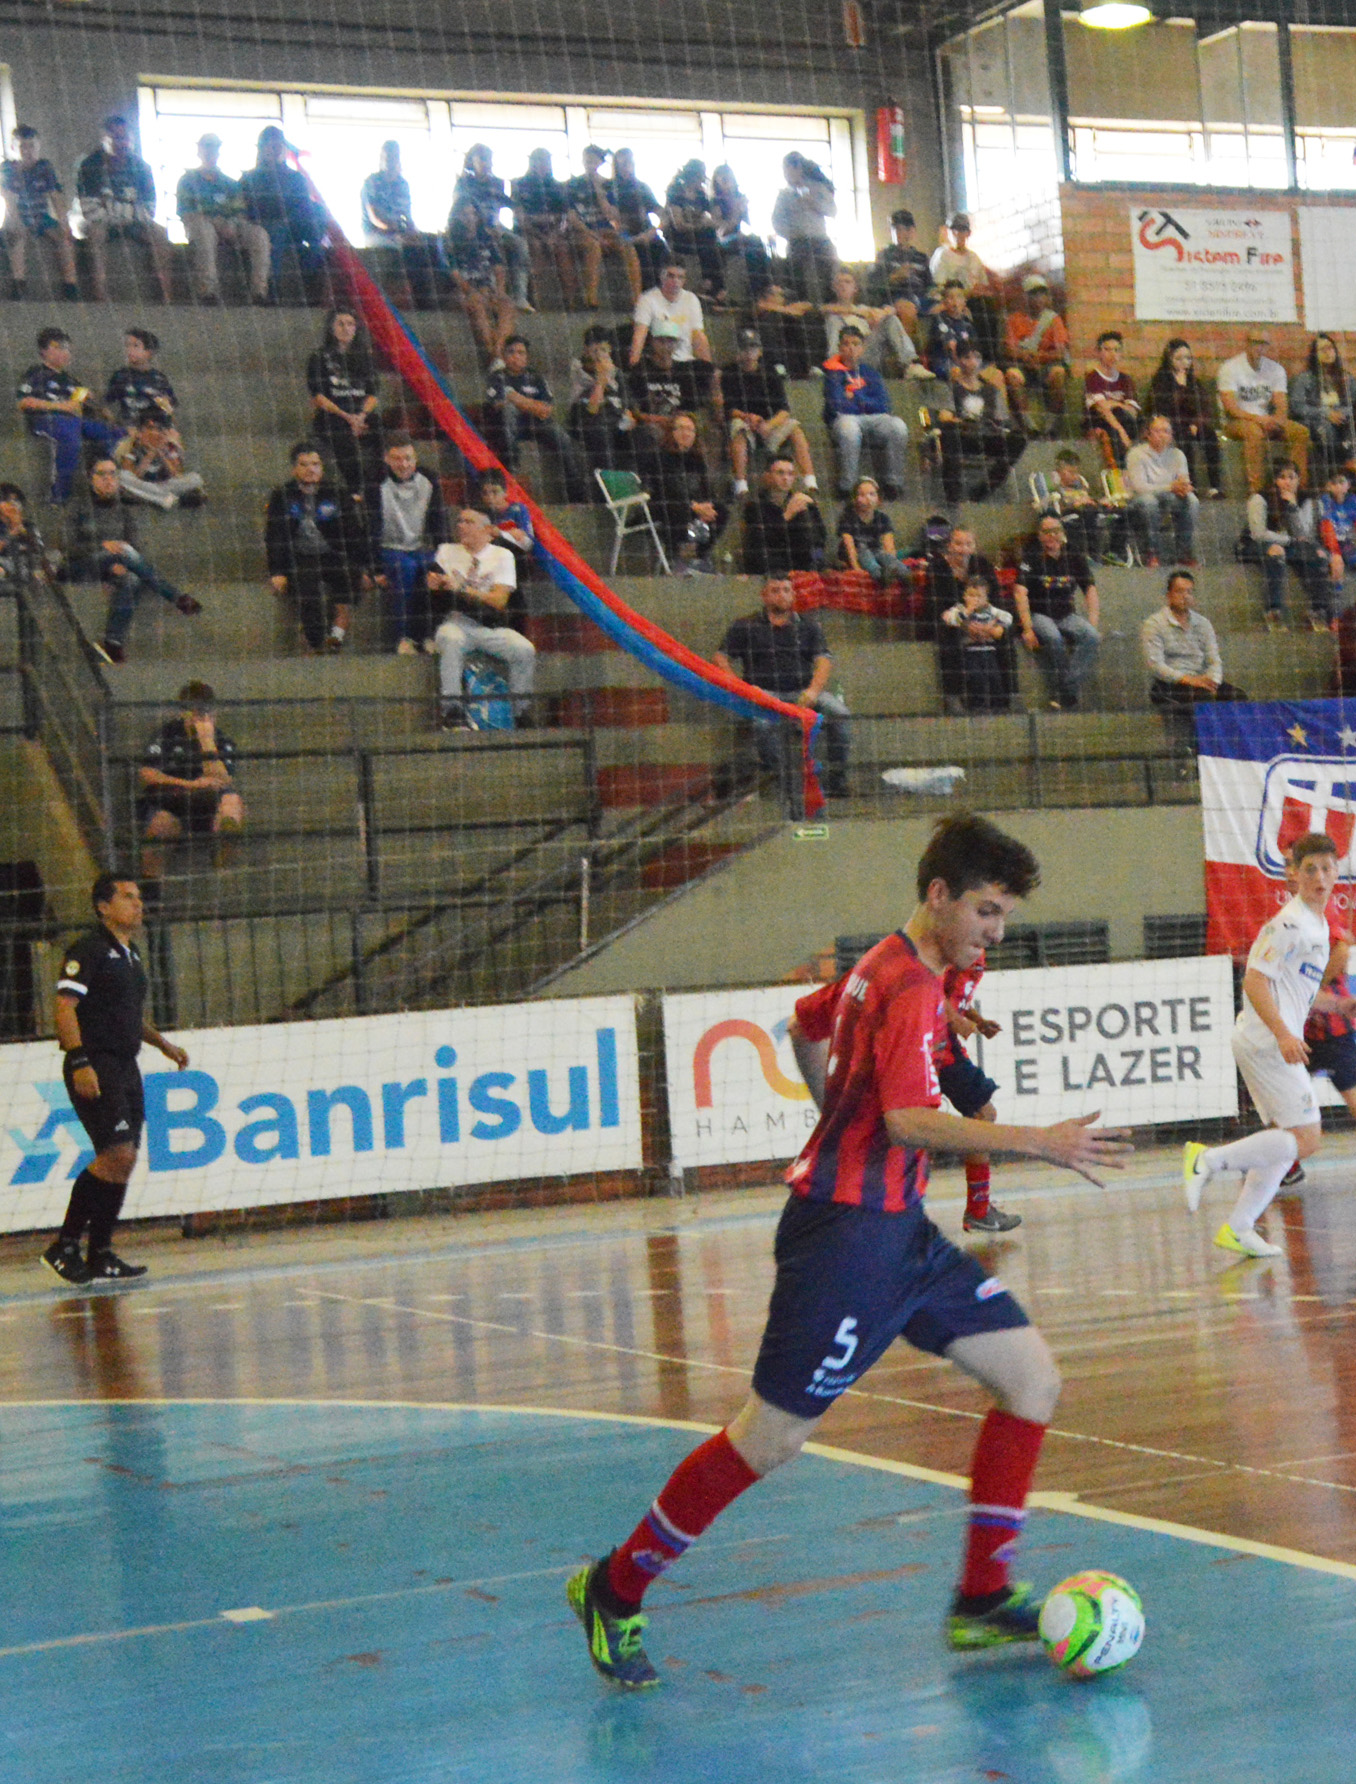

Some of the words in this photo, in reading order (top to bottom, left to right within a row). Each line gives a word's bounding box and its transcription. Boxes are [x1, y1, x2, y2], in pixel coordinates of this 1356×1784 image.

[1012, 996, 1212, 1047] ESPORTE
[1015, 1058, 1039, 1095] E
[1062, 1044, 1204, 1092] LAZER
[143, 1026, 621, 1173] Banrisul
[822, 1315, 859, 1371] 5
